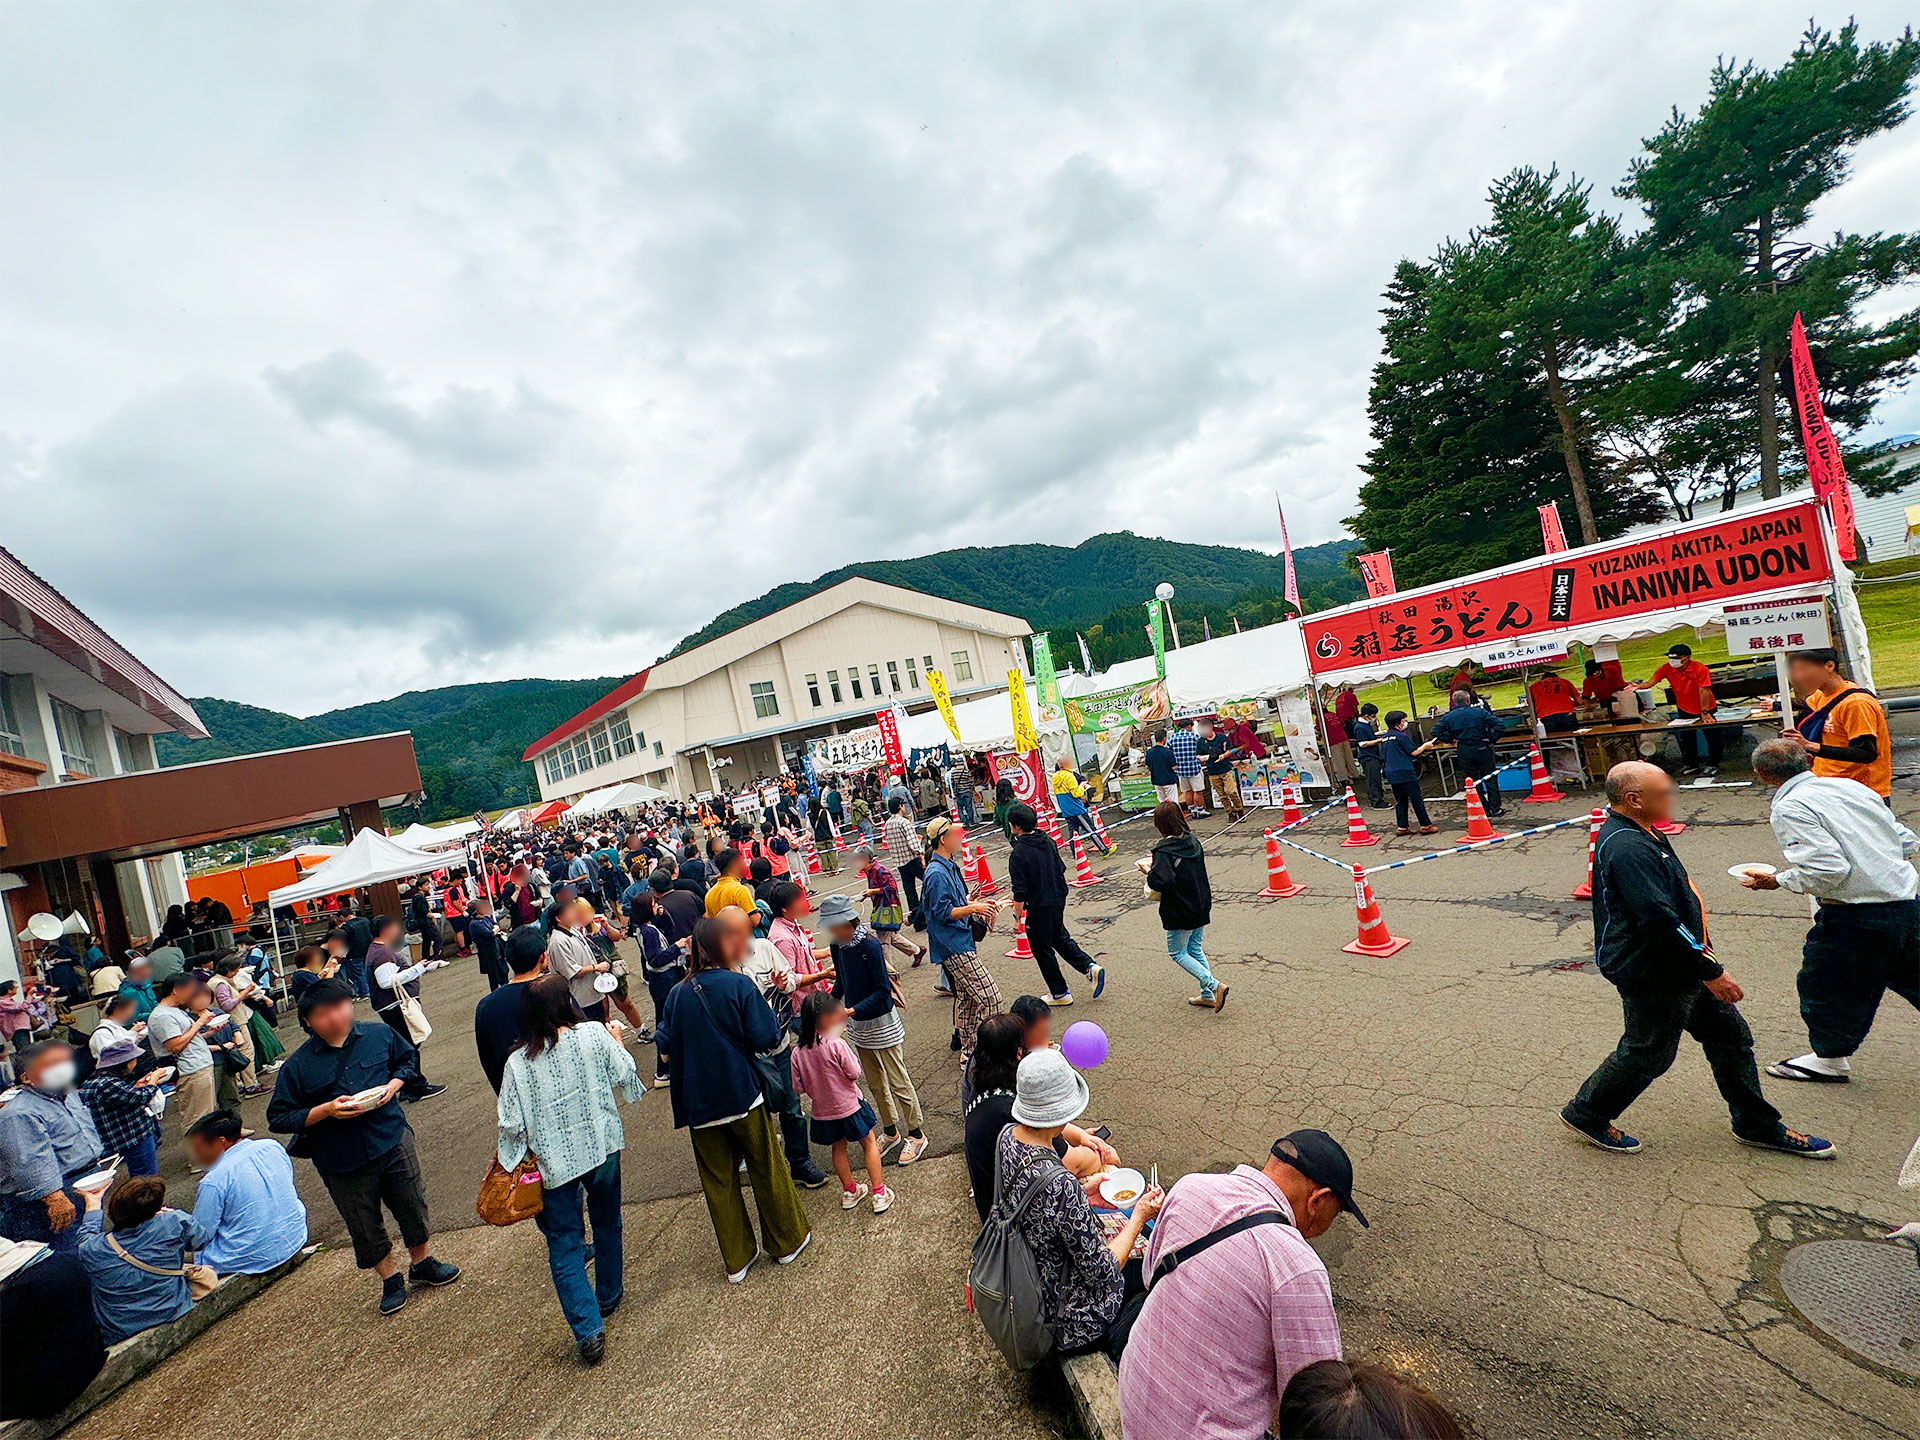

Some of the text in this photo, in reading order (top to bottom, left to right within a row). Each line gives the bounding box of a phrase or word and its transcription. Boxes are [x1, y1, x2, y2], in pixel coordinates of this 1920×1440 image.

[1588, 515, 1803, 578] YUZAWA, AKITA, JAPAN
[1552, 574, 1570, 617] 日本三大
[1592, 542, 1811, 610] INANIWA UDON
[1378, 590, 1482, 625] 秋田 湯沢
[1727, 608, 1822, 626] 稲庭うどん（秋田）
[1348, 601, 1533, 659] 稲庭うどん
[1749, 633, 1805, 649] 最後尾
